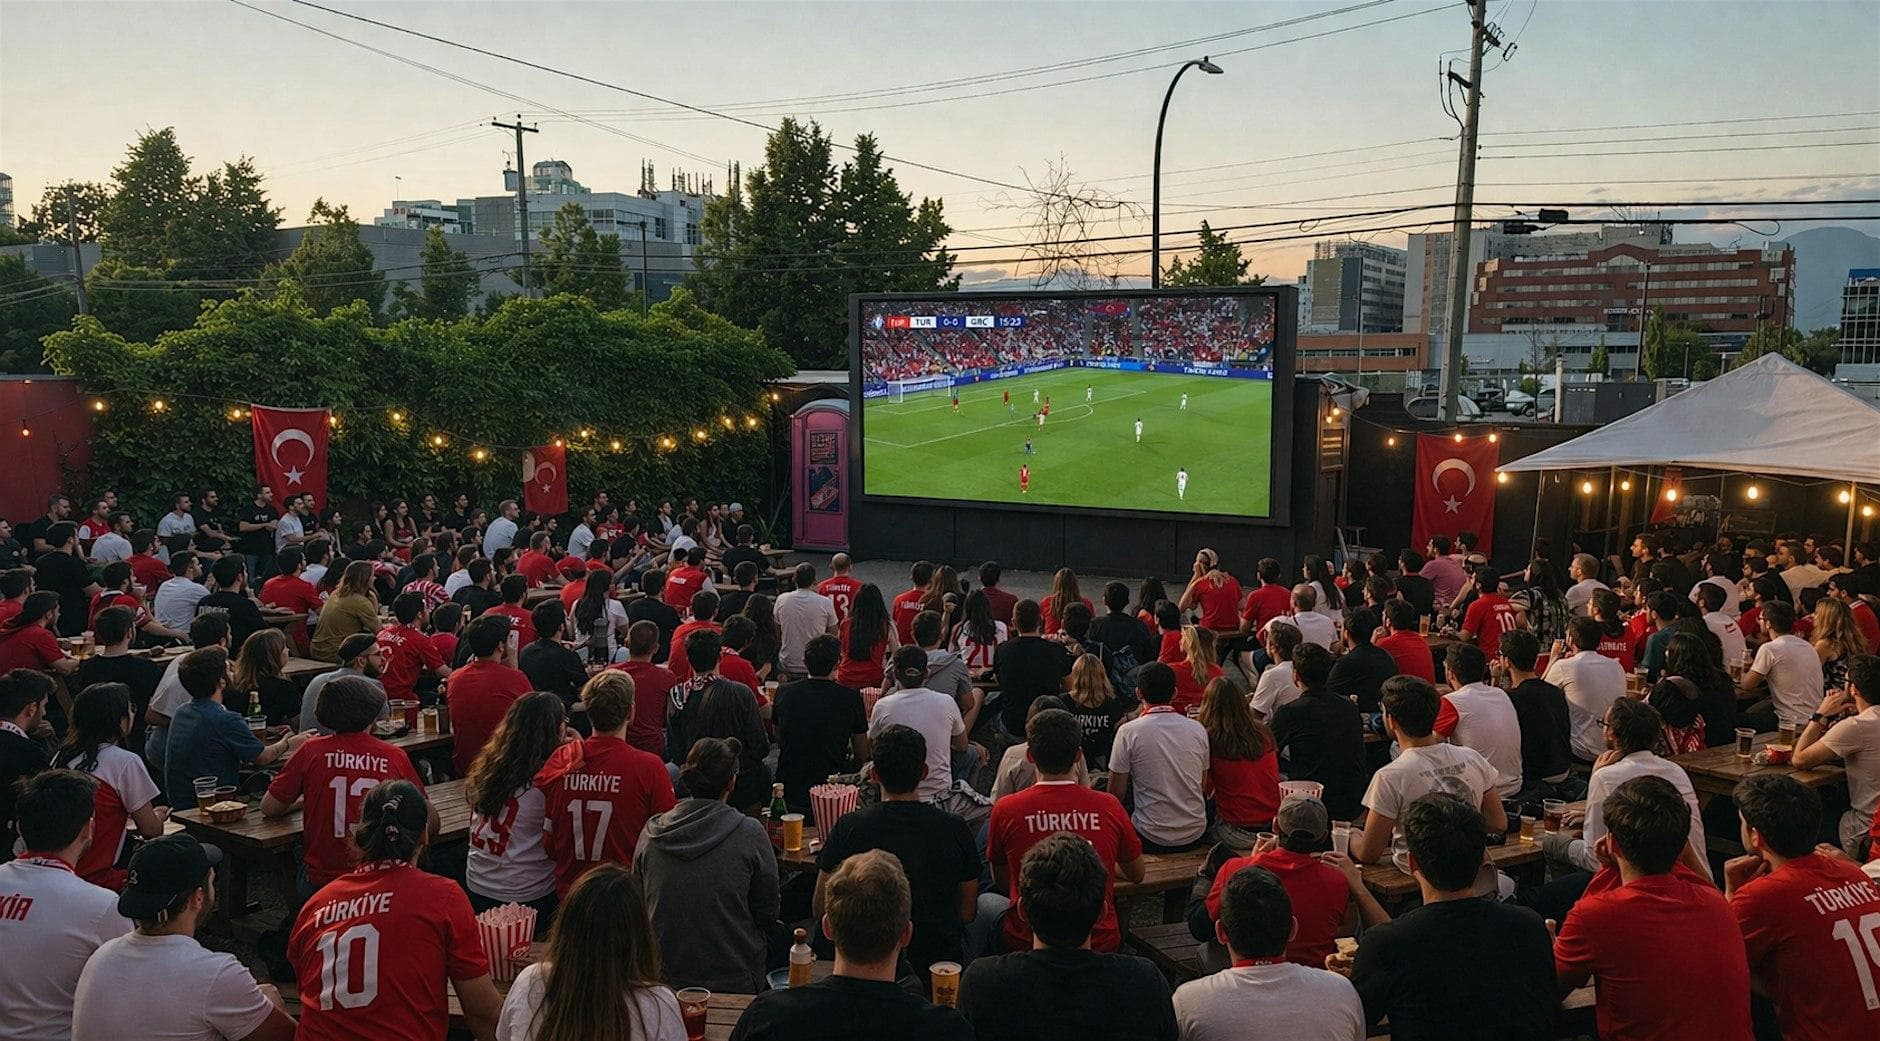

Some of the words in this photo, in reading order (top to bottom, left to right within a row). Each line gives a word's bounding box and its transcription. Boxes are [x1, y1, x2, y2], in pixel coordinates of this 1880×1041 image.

[915, 316, 932, 326] TUR
[1496, 612, 1517, 633] 10
[325, 749, 388, 774] TÜRKİYE
[567, 799, 613, 861] 17
[1024, 809, 1101, 833] TÜRKİYE
[314, 892, 394, 928] TÜRKİYE
[1803, 881, 1880, 915] TÜRKİYE
[316, 923, 380, 1011] 10
